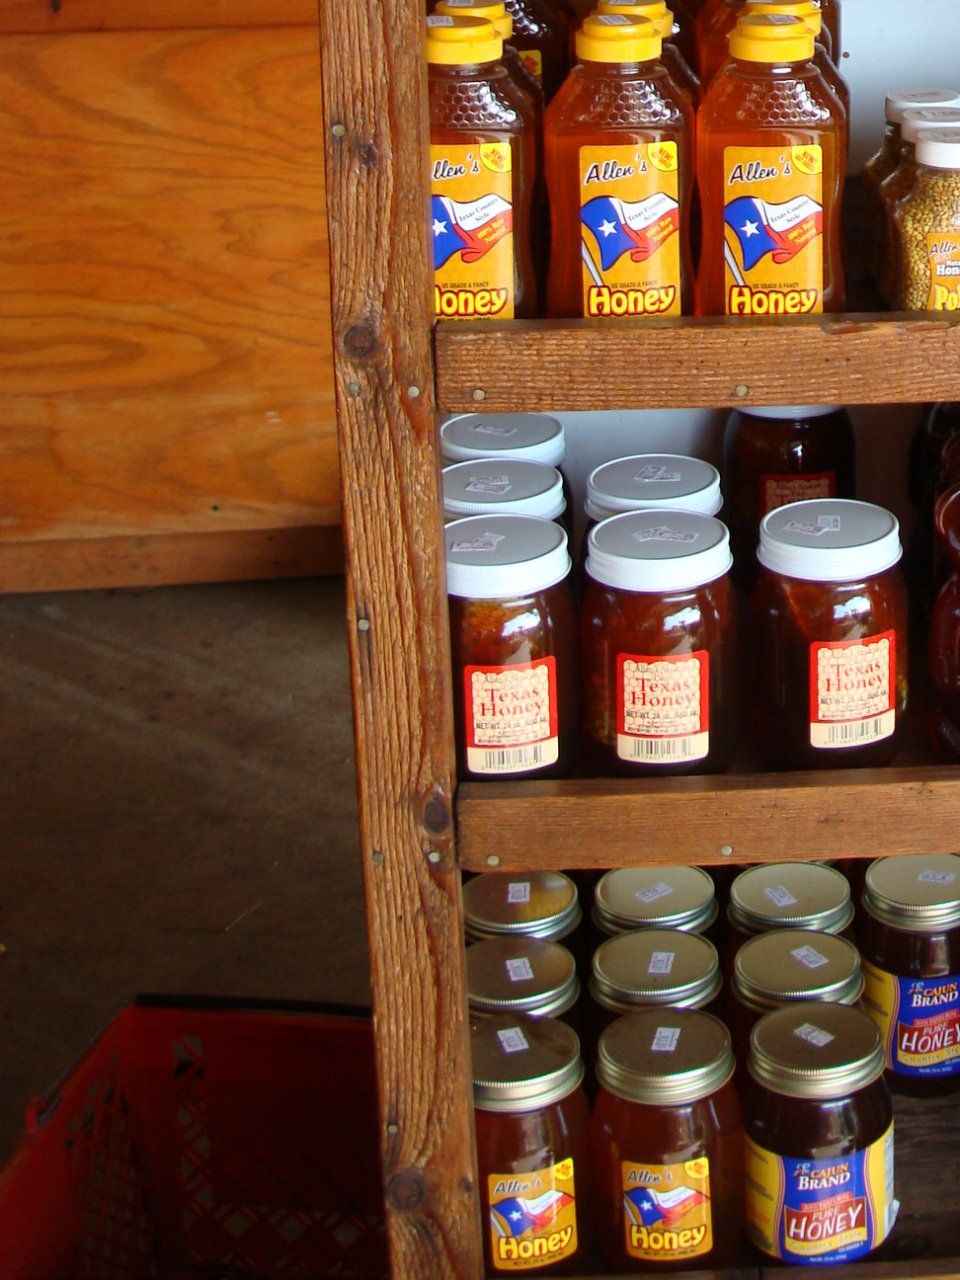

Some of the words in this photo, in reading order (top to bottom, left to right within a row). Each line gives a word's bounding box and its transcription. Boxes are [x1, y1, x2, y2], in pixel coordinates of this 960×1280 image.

[433, 153, 480, 180] llen's
[585, 154, 648, 186] Allen's
[729, 156, 792, 185] Allen's
[588, 285, 676, 317] Honey
[730, 285, 818, 316] Honey
[830, 661, 881, 679] Texas
[636, 678, 691, 693] Texas
[825, 675, 883, 692] Honey
[485, 687, 540, 703] Texas
[631, 691, 692, 708] Honey
[481, 701, 542, 717] Honey
[923, 982, 957, 997] CAJUN
[911, 991, 959, 1007] BRAND
[810, 1162, 849, 1178] CAJUN
[798, 1171, 851, 1190] BRAND
[789, 1203, 863, 1240] HONEY
[499, 1225, 573, 1261] Honey
[630, 1224, 706, 1250] Honey
